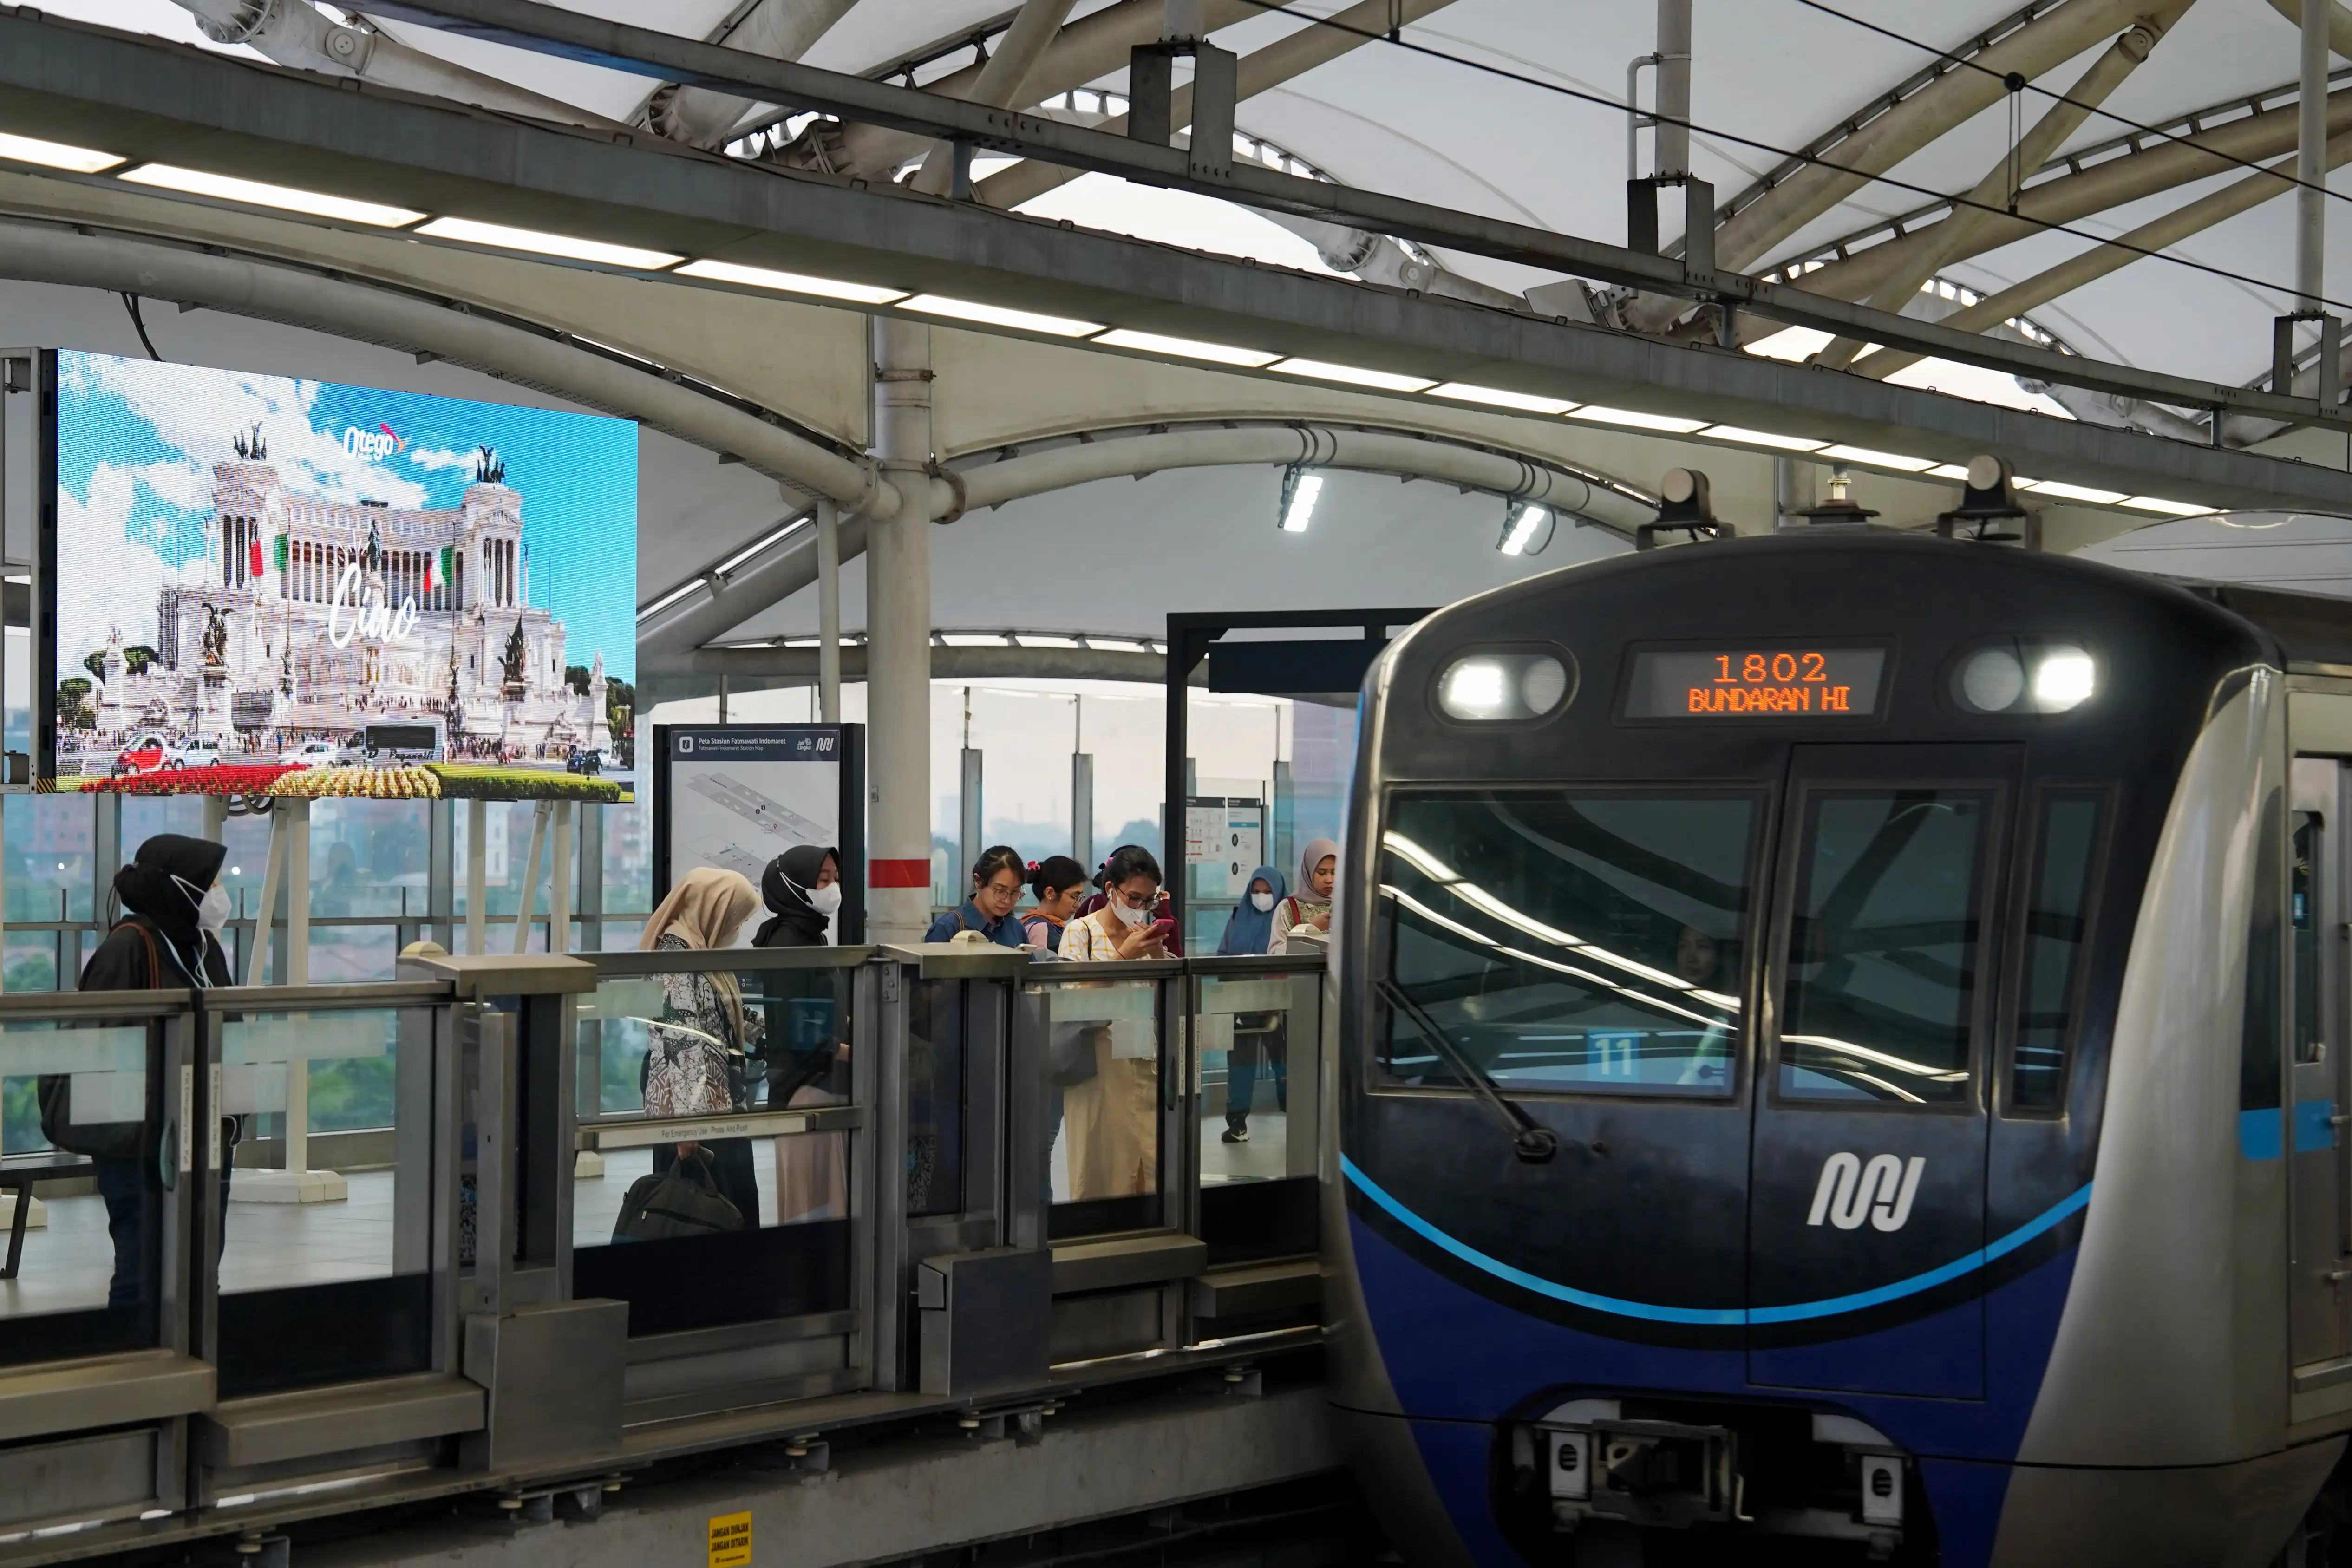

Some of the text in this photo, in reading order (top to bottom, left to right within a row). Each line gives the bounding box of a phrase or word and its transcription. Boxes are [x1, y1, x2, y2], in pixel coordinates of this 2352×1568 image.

[344, 426, 394, 461] Otego
[1713, 653, 1827, 683] 1802
[1688, 686, 1851, 712] BUNDARAN HI
[671, 1129, 697, 1138] Emergency
[698, 1127, 708, 1136] Use
[736, 1124, 749, 1132] Push
[711, 1526, 730, 1539] JANGAN
[711, 1540, 730, 1553] JANGAN
